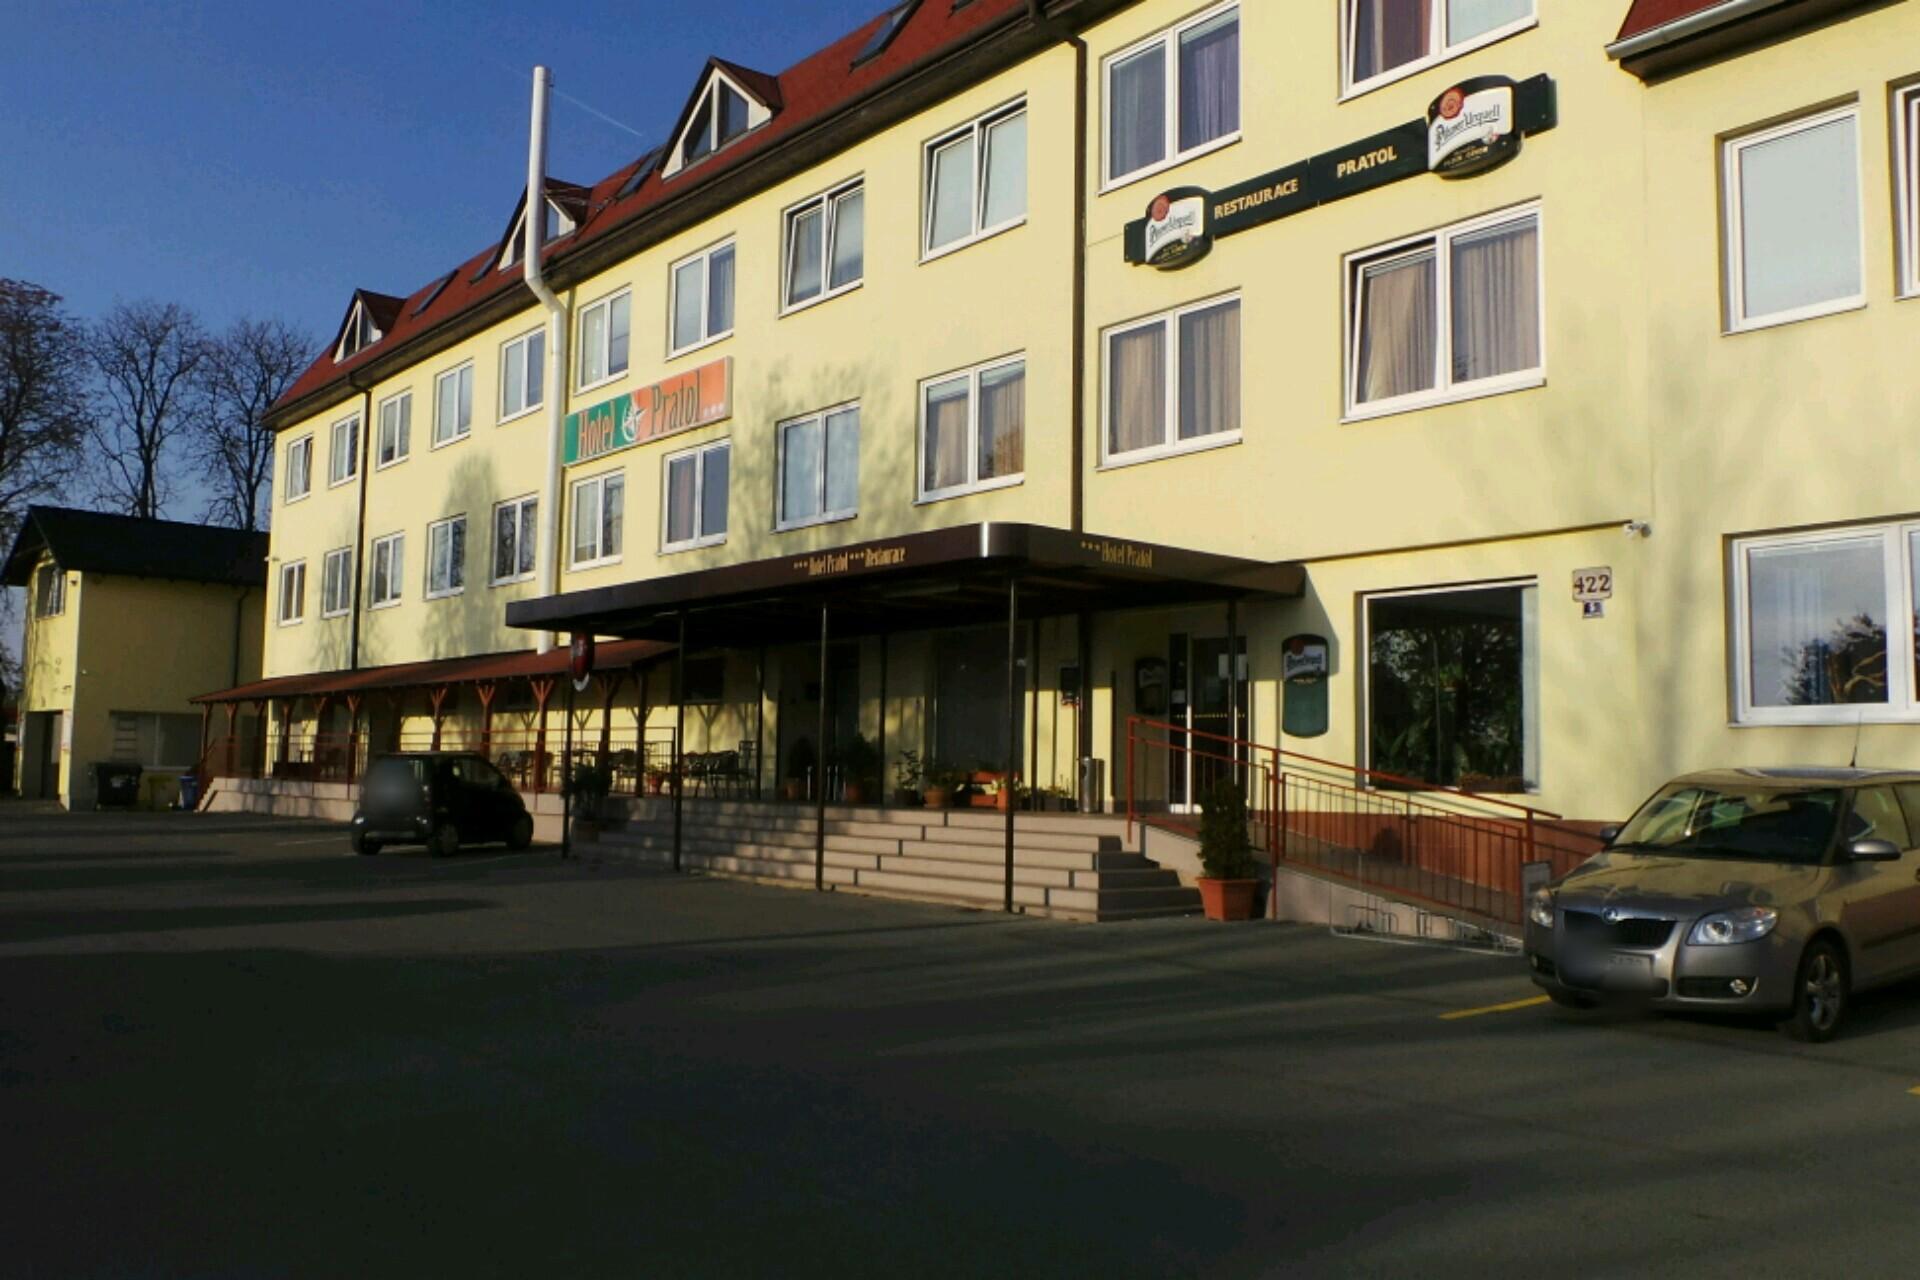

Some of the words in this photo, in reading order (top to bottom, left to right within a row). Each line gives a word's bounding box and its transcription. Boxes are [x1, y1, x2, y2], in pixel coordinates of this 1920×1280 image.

[1213, 179, 1299, 219] RESTAURACE
[1336, 146, 1398, 178] PRATOL
[577, 400, 615, 458] Hotel
[651, 369, 701, 434] Pratol
[1102, 541, 1125, 565] Hotel
[1573, 574, 1610, 595] 422
